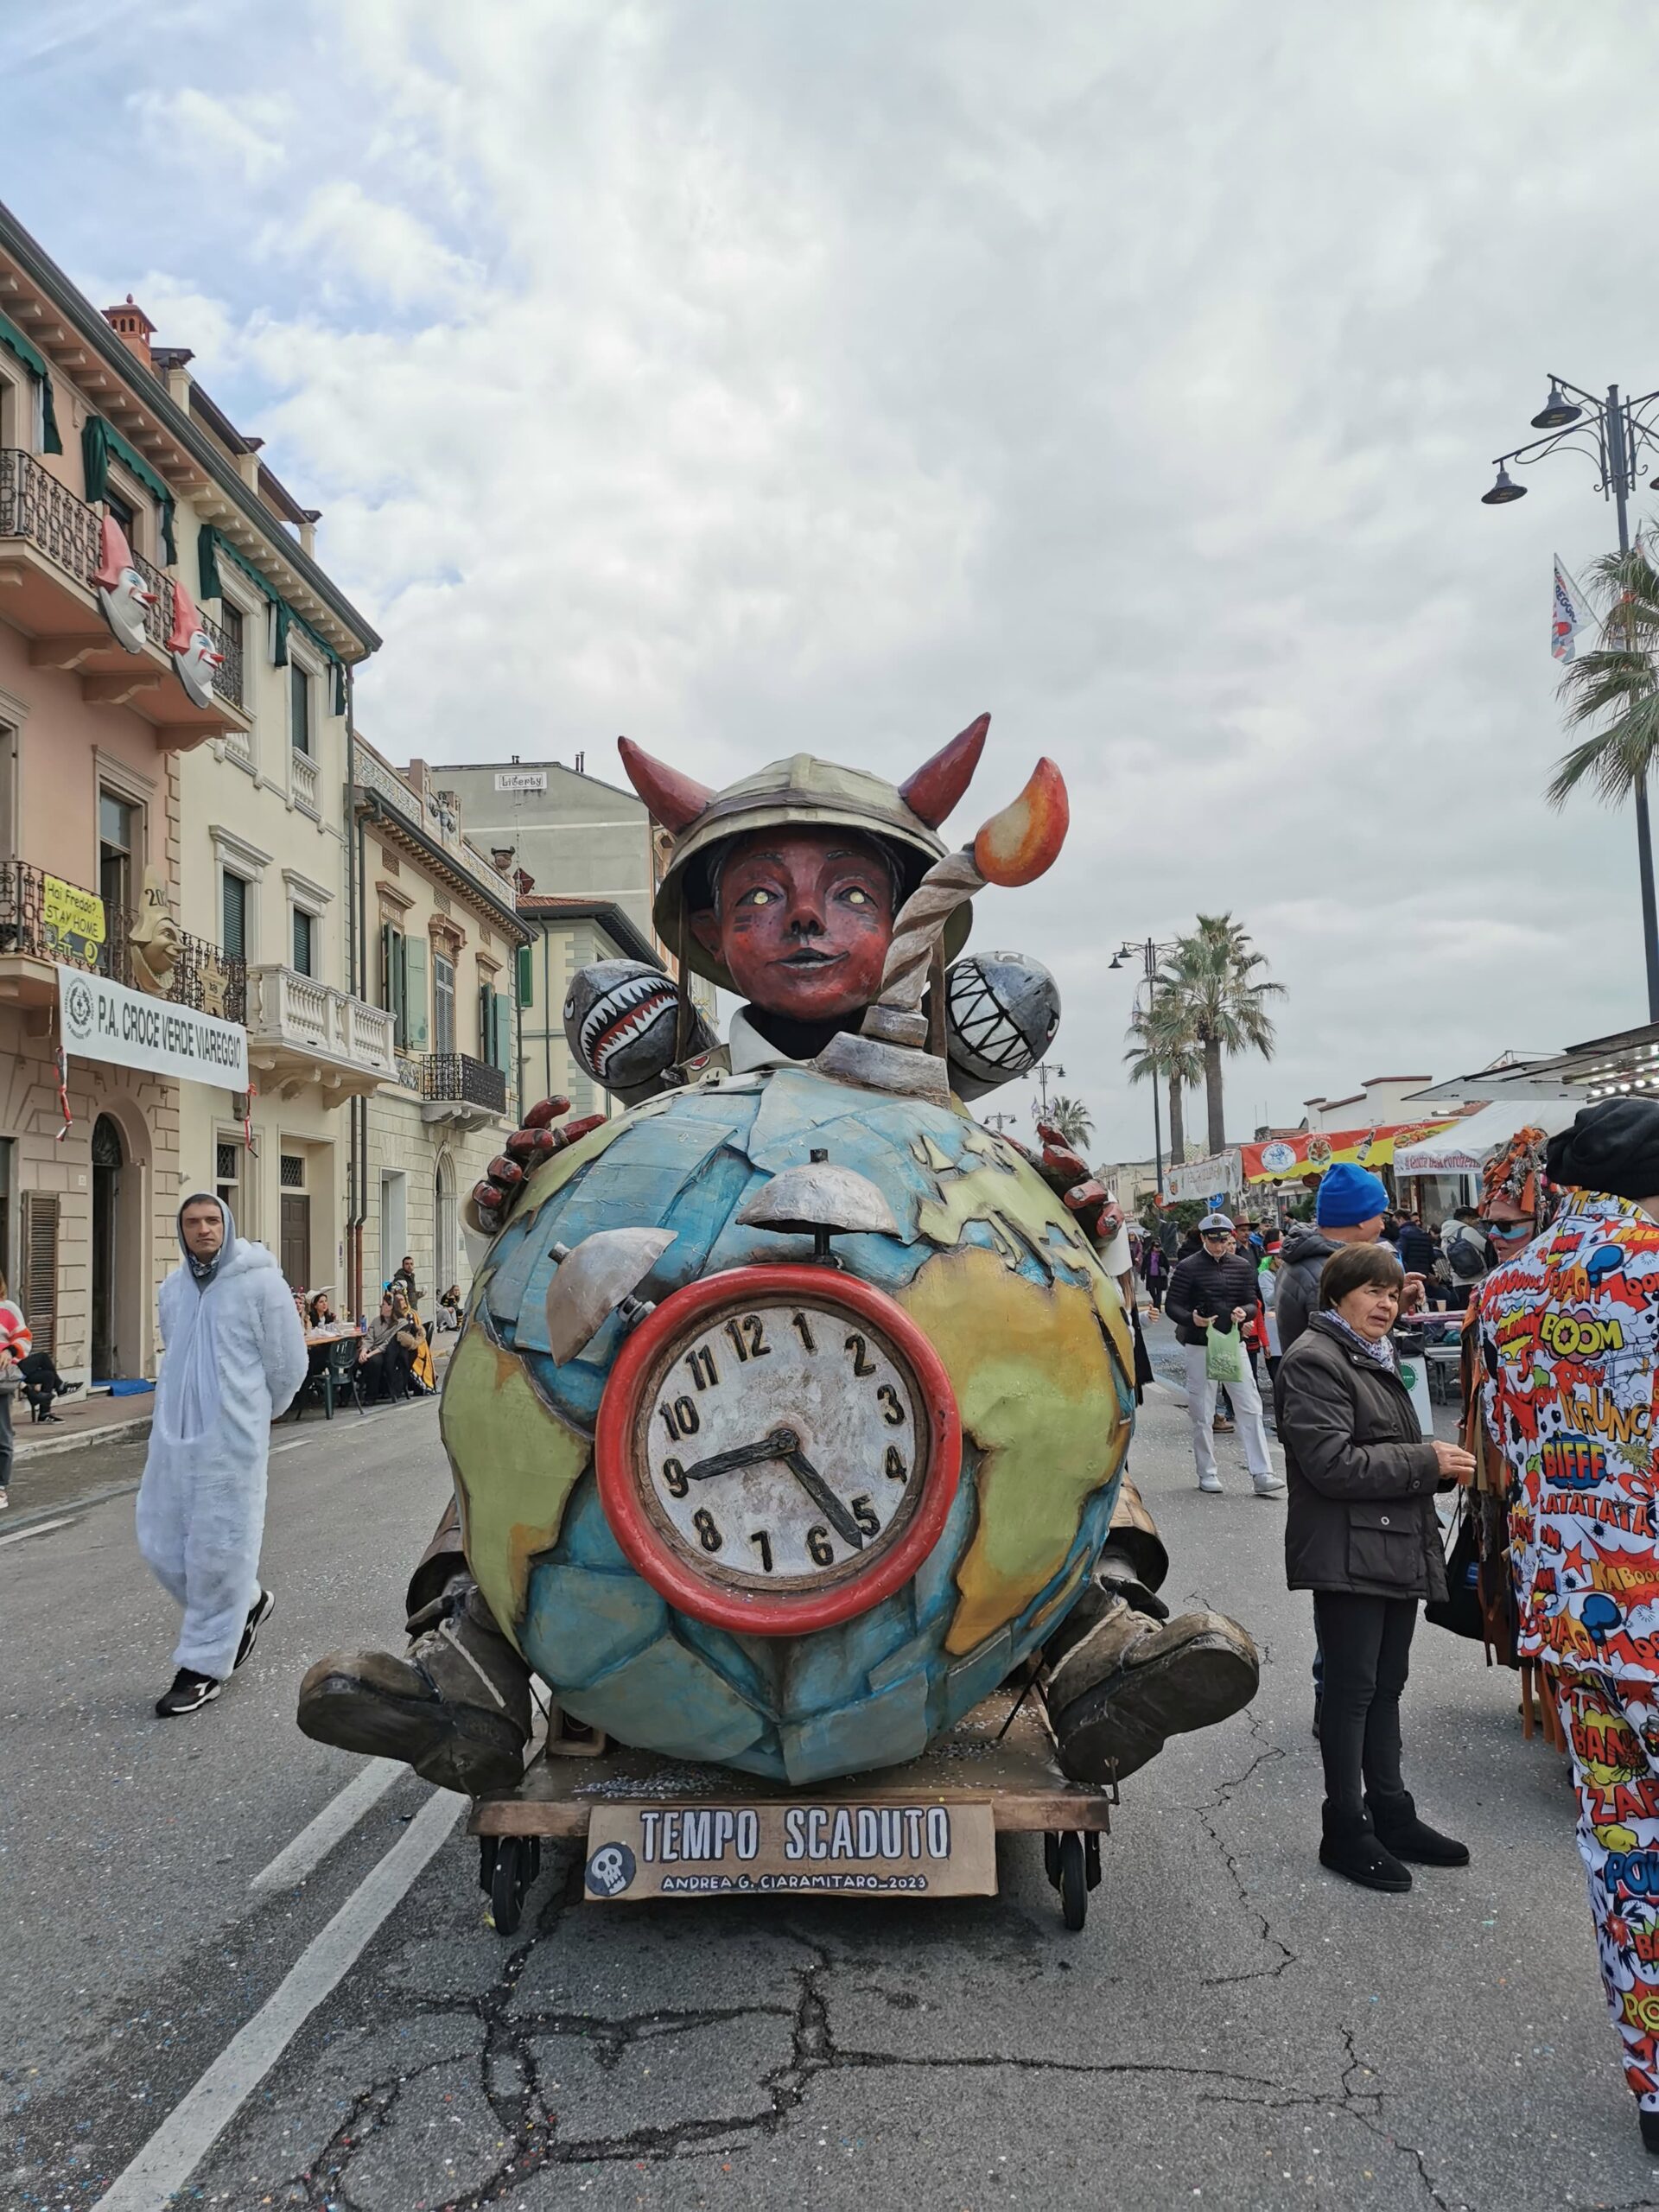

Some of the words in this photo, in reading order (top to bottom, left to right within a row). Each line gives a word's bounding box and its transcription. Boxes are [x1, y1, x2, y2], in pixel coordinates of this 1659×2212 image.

[502, 776, 542, 787] Liberty
[46, 904, 72, 925] STAY
[73, 915, 99, 938] HOME
[98, 995, 119, 1038] P.A.
[123, 1002, 160, 1048] CROCE
[162, 1014, 194, 1057] VERDE
[195, 1024, 241, 1071] VIAREGGIO
[725, 1314, 772, 1363] 12
[792, 1312, 817, 1352] 1
[1541, 1312, 1624, 1357] BOOM
[685, 1344, 720, 1391] 11
[844, 1333, 877, 1377] 2
[659, 1395, 701, 1441] 10
[876, 1383, 905, 1426] 3
[1558, 1386, 1653, 1444] KRUNC
[663, 1457, 689, 1498] 9
[885, 1445, 908, 1484] 4
[693, 1509, 722, 1553] 8
[850, 1494, 881, 1538] 5
[751, 1530, 772, 1573] 7
[807, 1524, 834, 1567] 6
[640, 1808, 760, 1862] TEMPO
[785, 1807, 950, 1859] SCADUTO
[662, 1876, 732, 1890] ANDREA
[738, 1876, 754, 1890] G.
